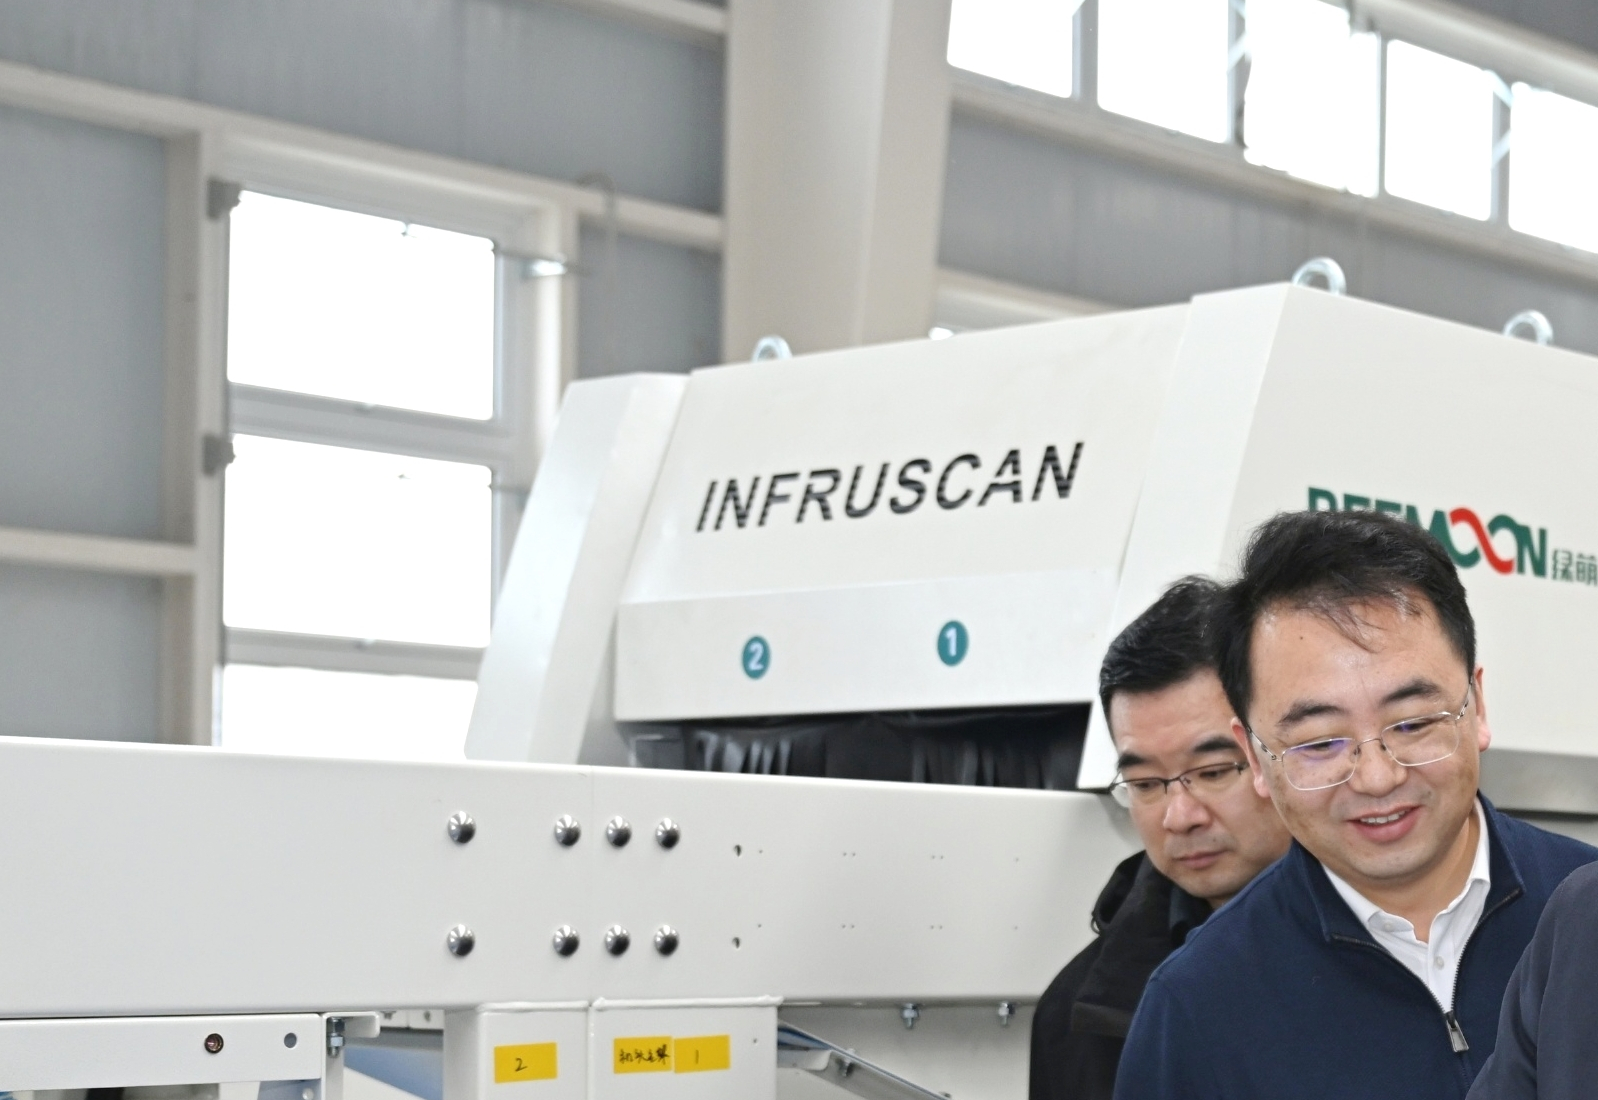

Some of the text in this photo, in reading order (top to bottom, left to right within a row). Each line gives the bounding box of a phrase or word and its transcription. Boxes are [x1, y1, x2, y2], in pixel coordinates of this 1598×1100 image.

[695, 442, 1085, 533] INFRUSCAN
[748, 641, 765, 672] 2
[943, 628, 958, 656] 1
[514, 1057, 528, 1072] 2
